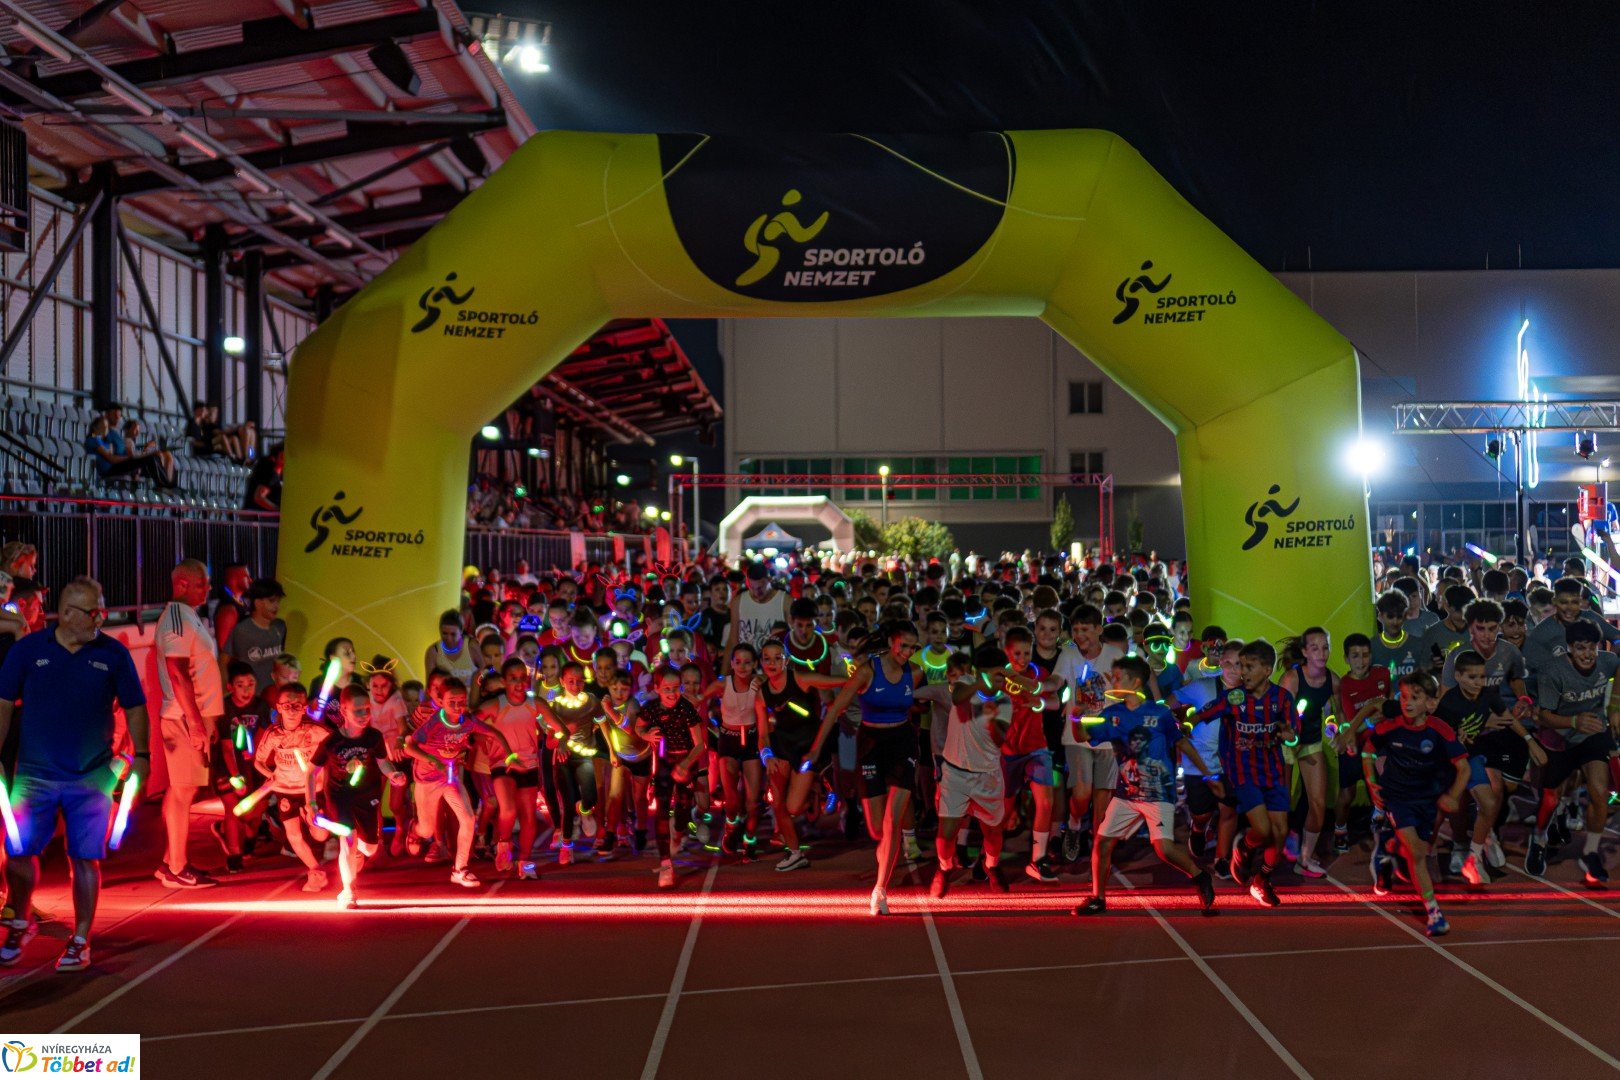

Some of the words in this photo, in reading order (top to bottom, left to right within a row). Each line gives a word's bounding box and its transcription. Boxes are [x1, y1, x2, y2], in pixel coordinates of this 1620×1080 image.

[803, 241, 926, 266] SPORTOLÓ
[784, 271, 876, 287] NEMZET
[1156, 290, 1237, 309] SPORTOLÓ
[457, 310, 539, 325] SPORTOLÓ
[1144, 310, 1206, 324] NEMZET
[444, 325, 506, 338] NEMZET
[1286, 514, 1355, 533] SPORTOLÓ
[345, 529, 425, 545] SPORTOLÓ
[1273, 535, 1333, 549] NEMZET
[331, 544, 393, 558] NEMZET
